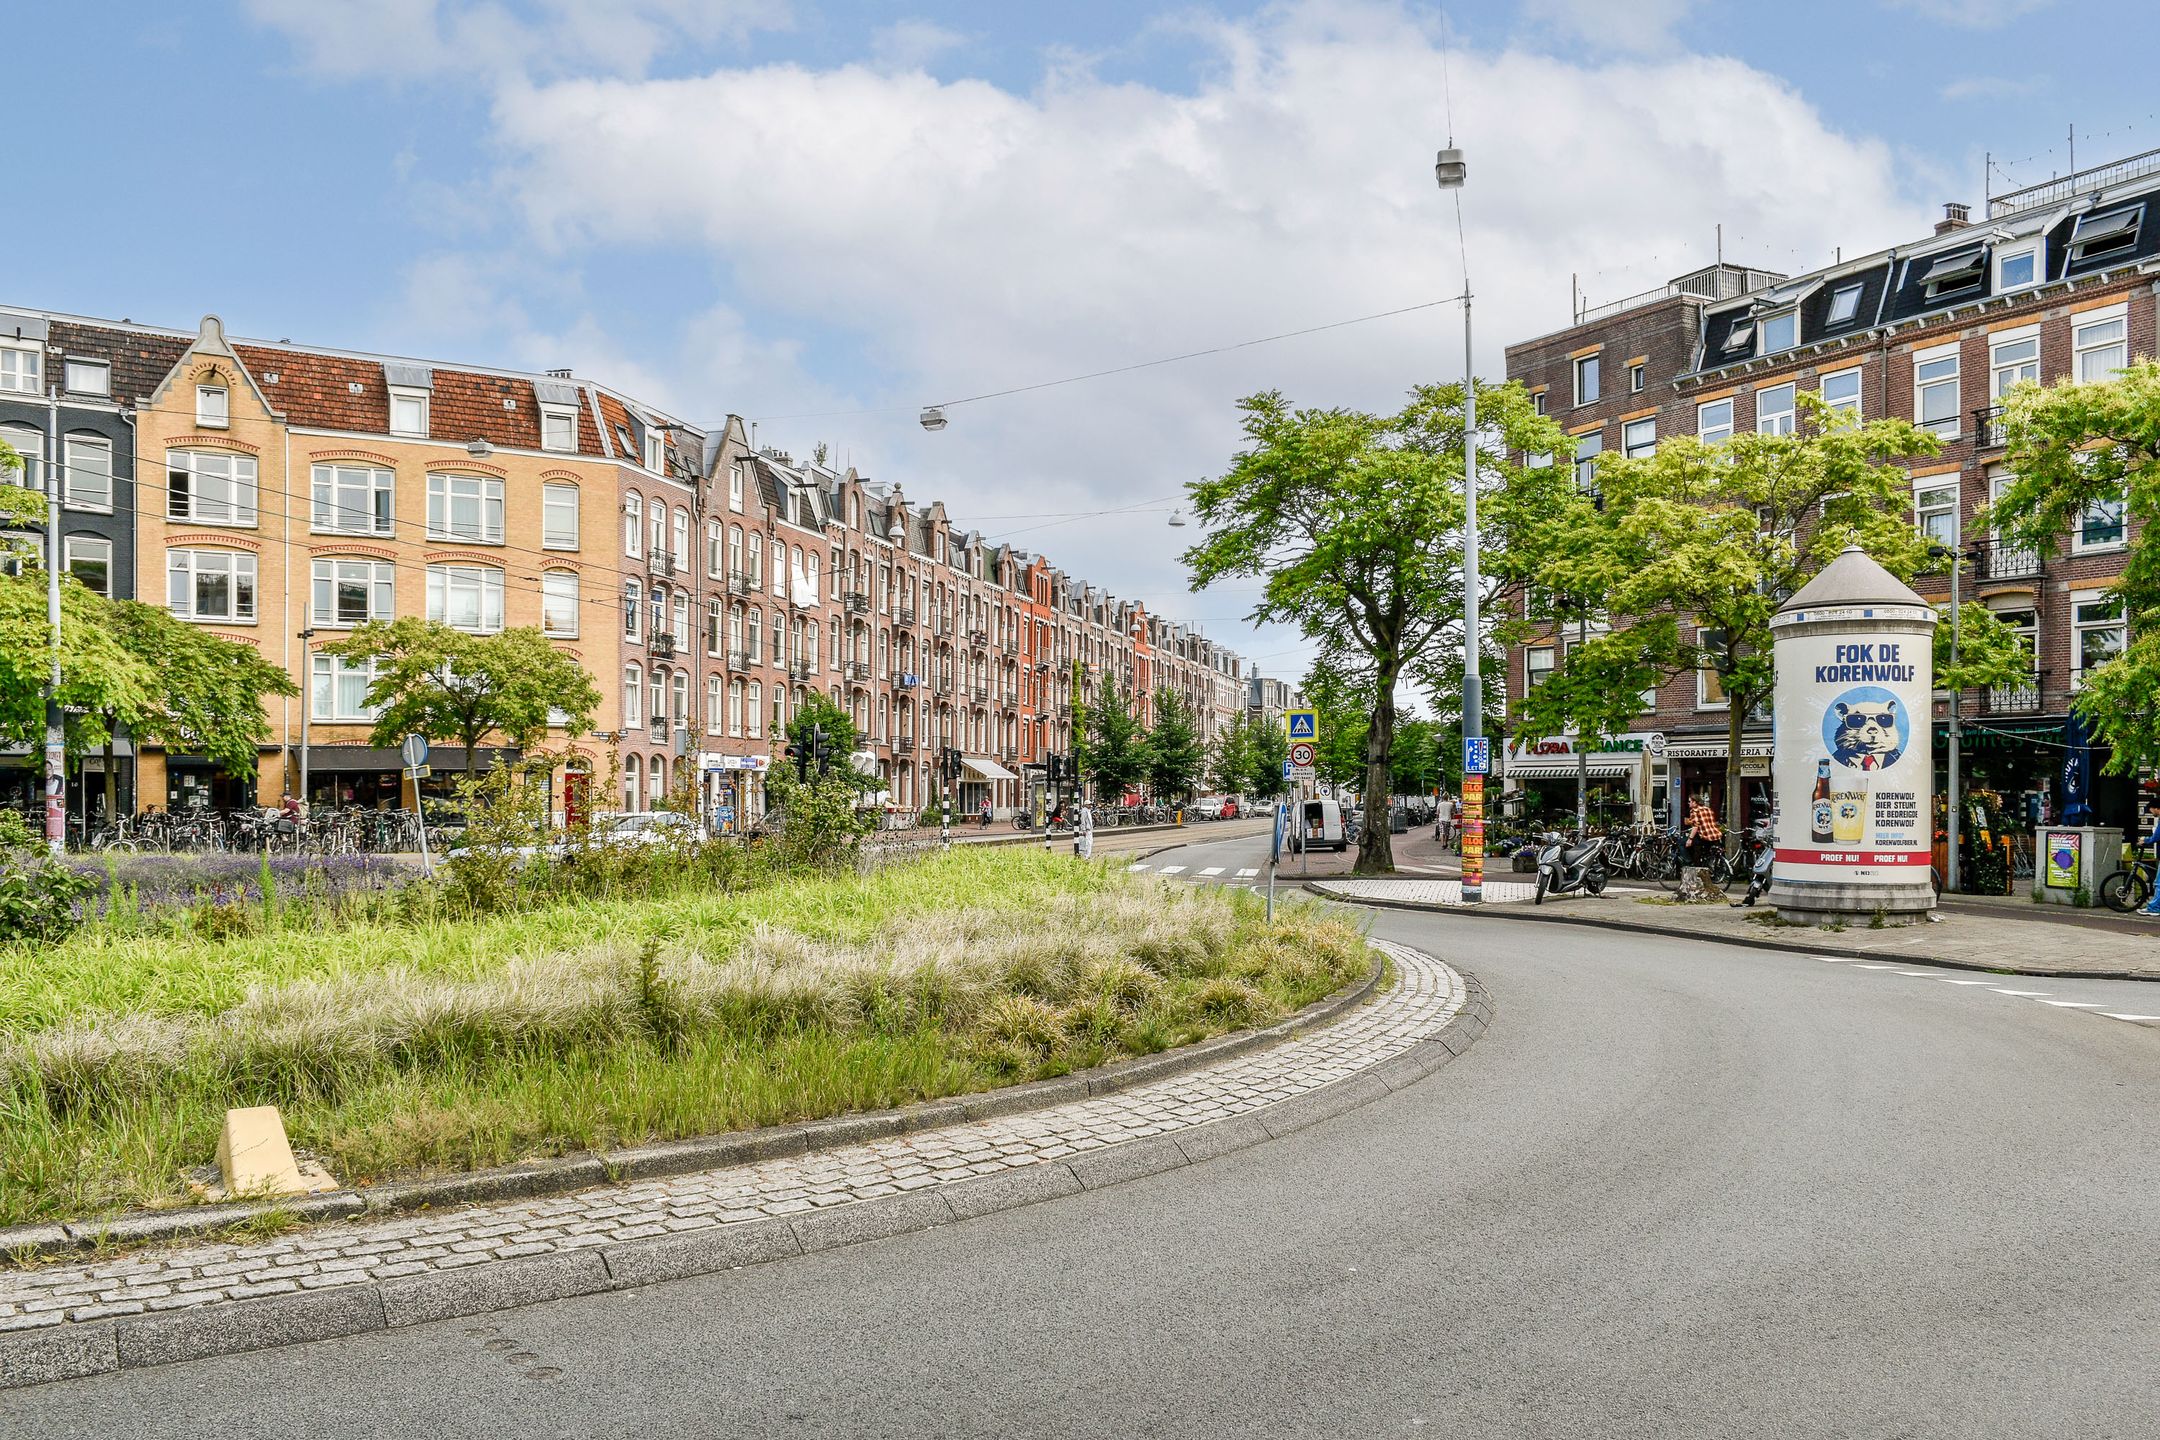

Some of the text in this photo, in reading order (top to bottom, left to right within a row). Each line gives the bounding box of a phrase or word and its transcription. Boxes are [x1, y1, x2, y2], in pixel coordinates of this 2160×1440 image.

[1836, 644, 1900, 663] FOK DE
[1816, 665, 1914, 683] KORENWOLF
[1573, 739, 1643, 753] RANCE
[1295, 750, 1311, 760] 30
[1667, 748, 1774, 757] RISTORANTE PERIA N
[1875, 792, 1915, 800] KORENWOLF
[1875, 801, 1917, 809] BIER STEUNT
[1875, 810, 1918, 818] DE BEDREIGDE
[1875, 819, 1915, 827] KORENWOLF
[1820, 853, 1860, 862] PROEF NU!
[1873, 854, 1909, 863] PROEF NU!
